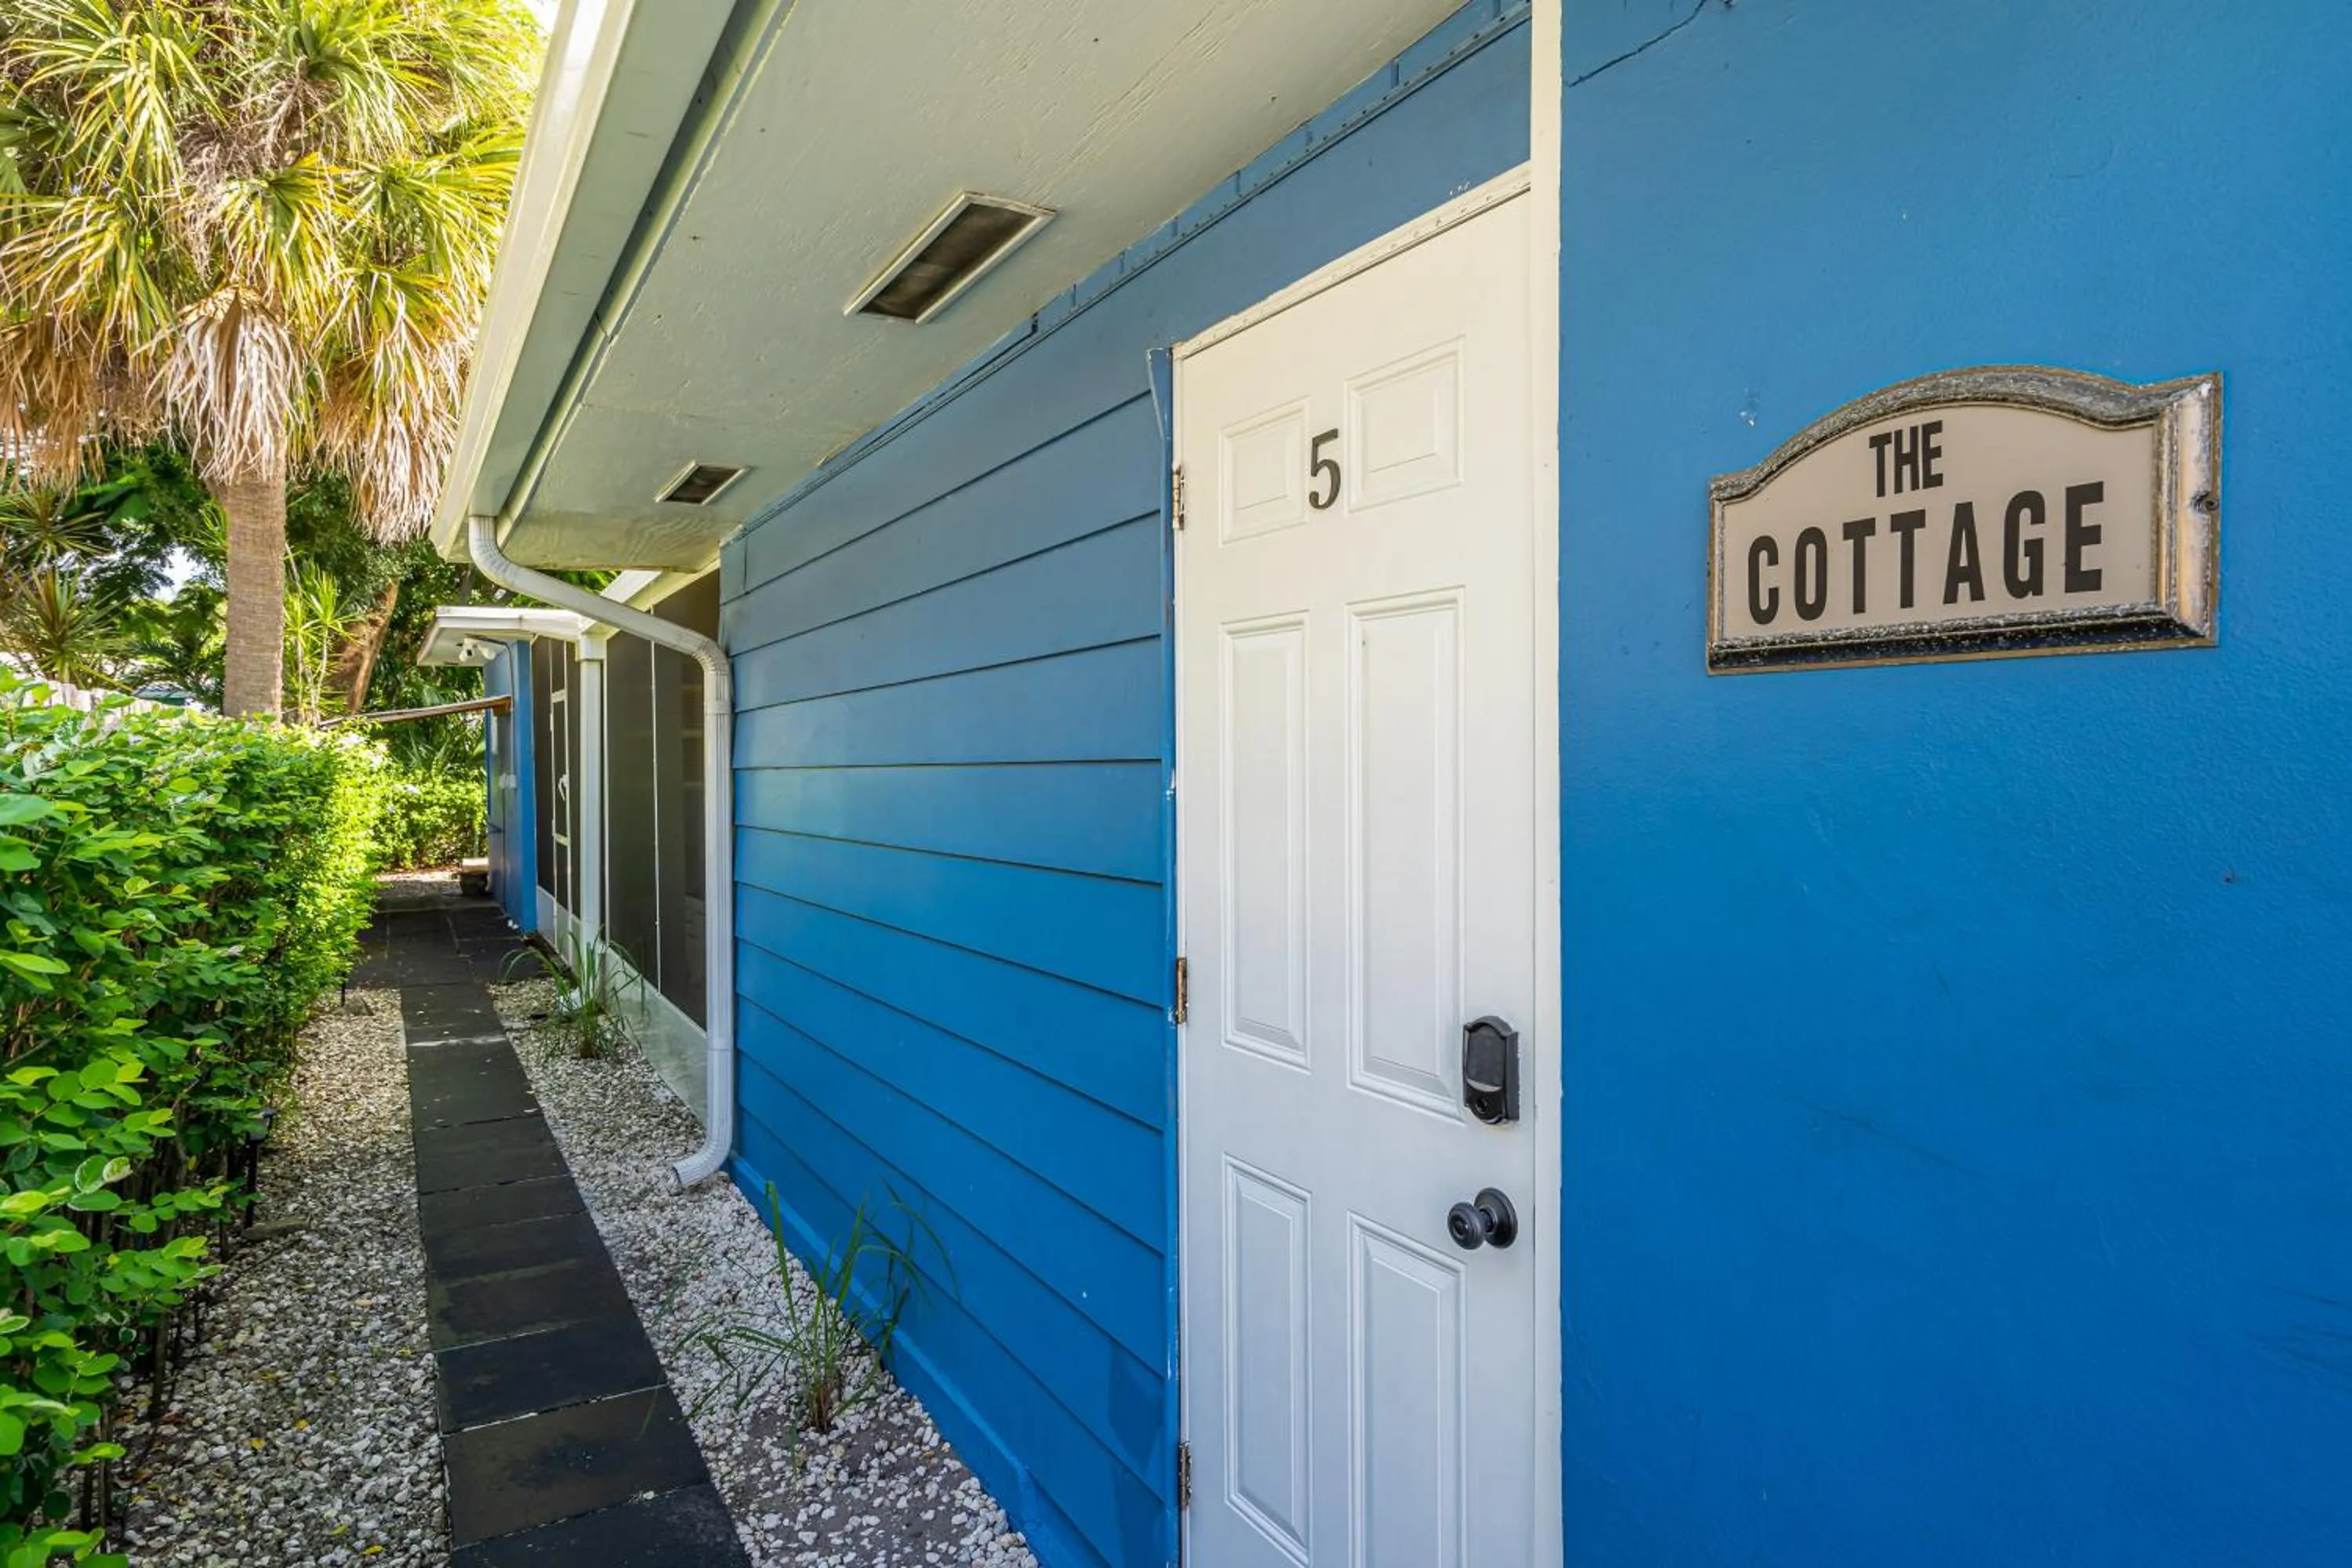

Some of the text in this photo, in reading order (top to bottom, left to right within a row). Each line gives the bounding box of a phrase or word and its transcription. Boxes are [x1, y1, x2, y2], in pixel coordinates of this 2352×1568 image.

[1308, 428, 1341, 510] 5
[1868, 419, 1944, 498] THE
[1748, 481, 2104, 625] COTTAGE
